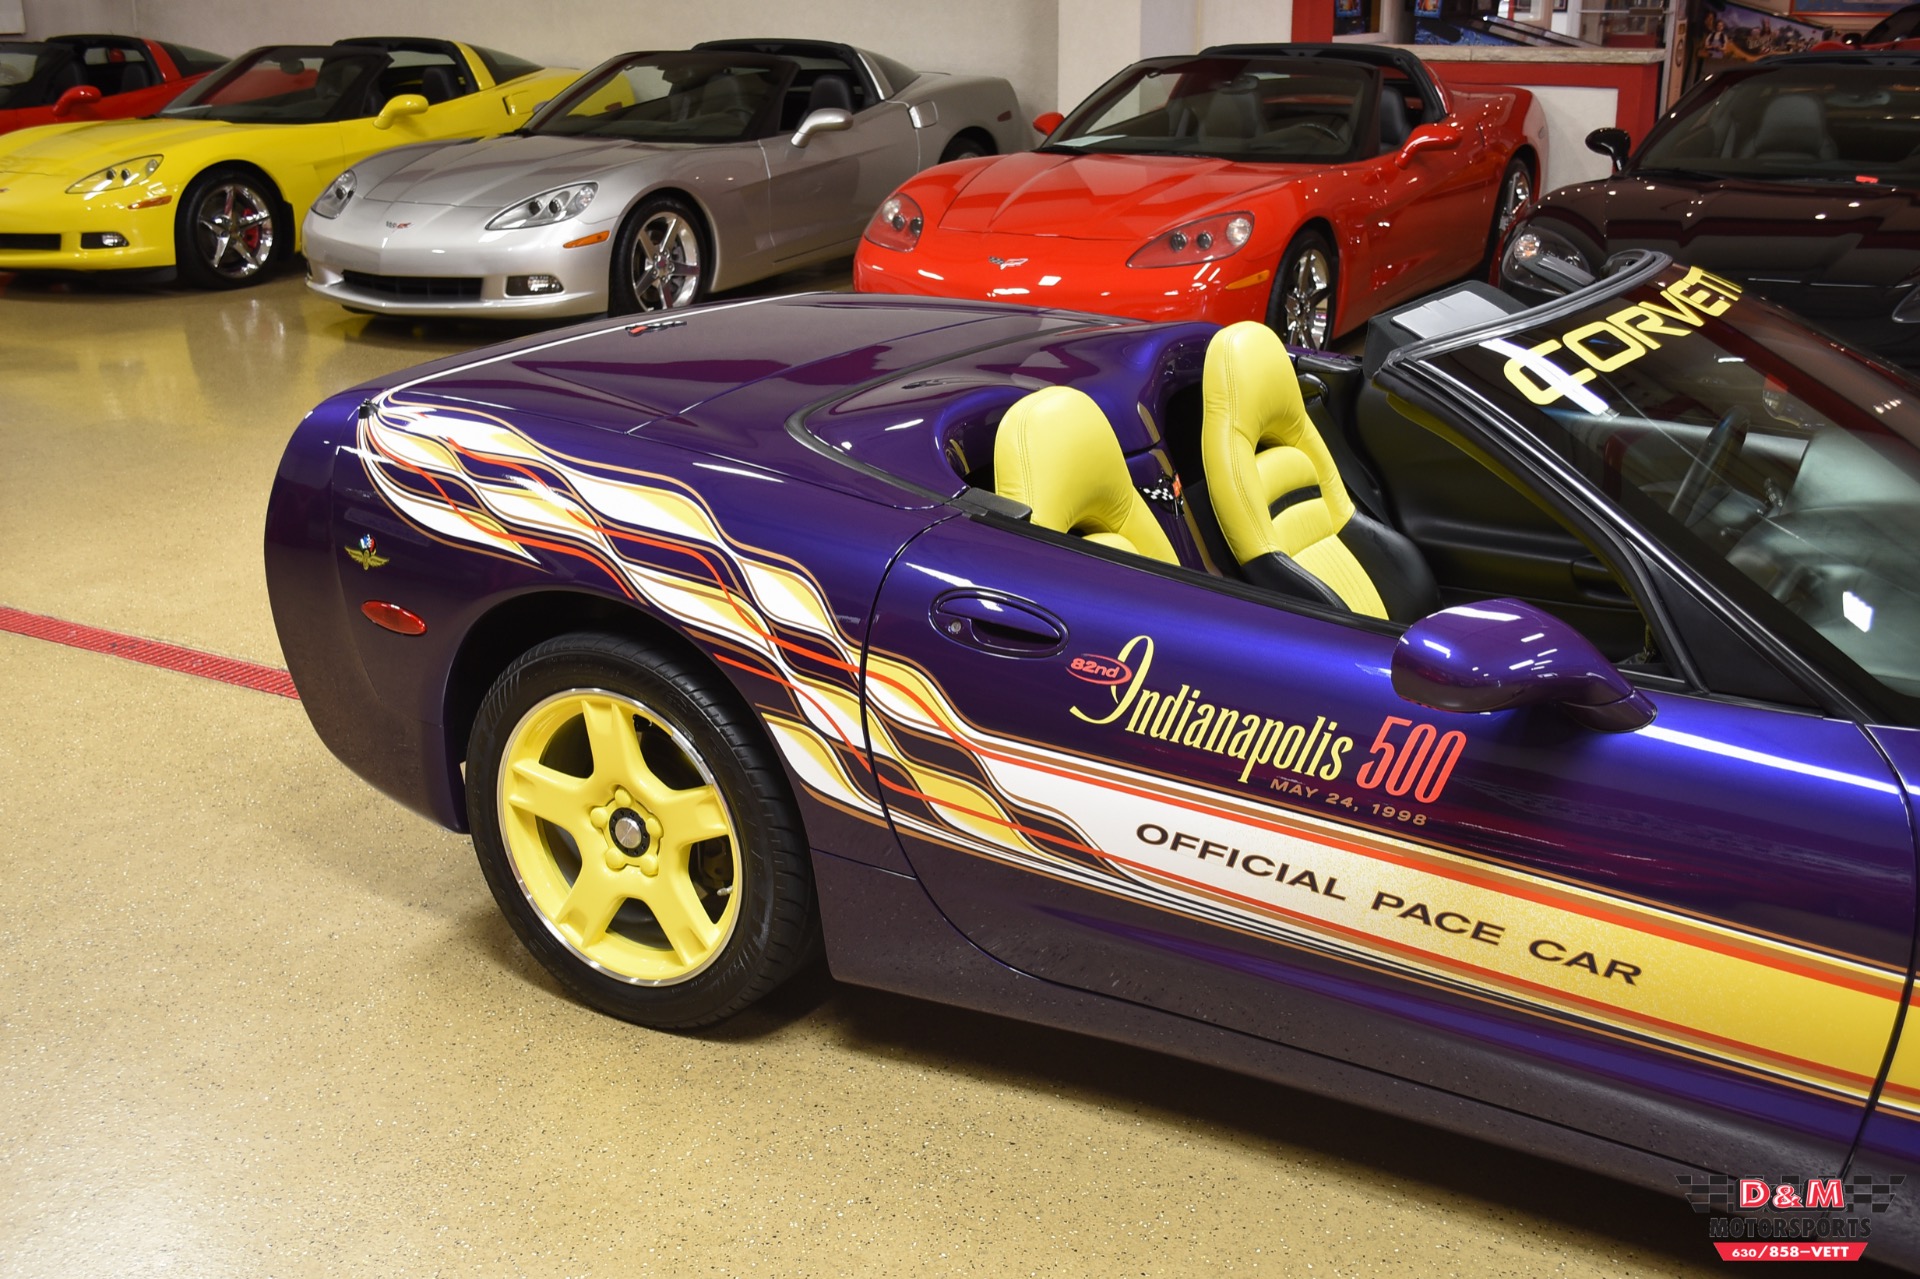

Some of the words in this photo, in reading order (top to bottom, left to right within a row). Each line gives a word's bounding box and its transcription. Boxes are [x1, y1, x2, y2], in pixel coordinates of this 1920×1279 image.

[1069, 635, 1354, 784] Indianapolis
[1356, 715, 1467, 804] 500
[1070, 657, 1119, 679] 82nd
[1269, 778, 1318, 799] MAY
[1328, 792, 1361, 812] 24,
[1371, 803, 1428, 827] 1998
[1135, 822, 1348, 902] OFFICIAL
[1370, 891, 1506, 947] PACE
[1528, 939, 1643, 986] CAR
